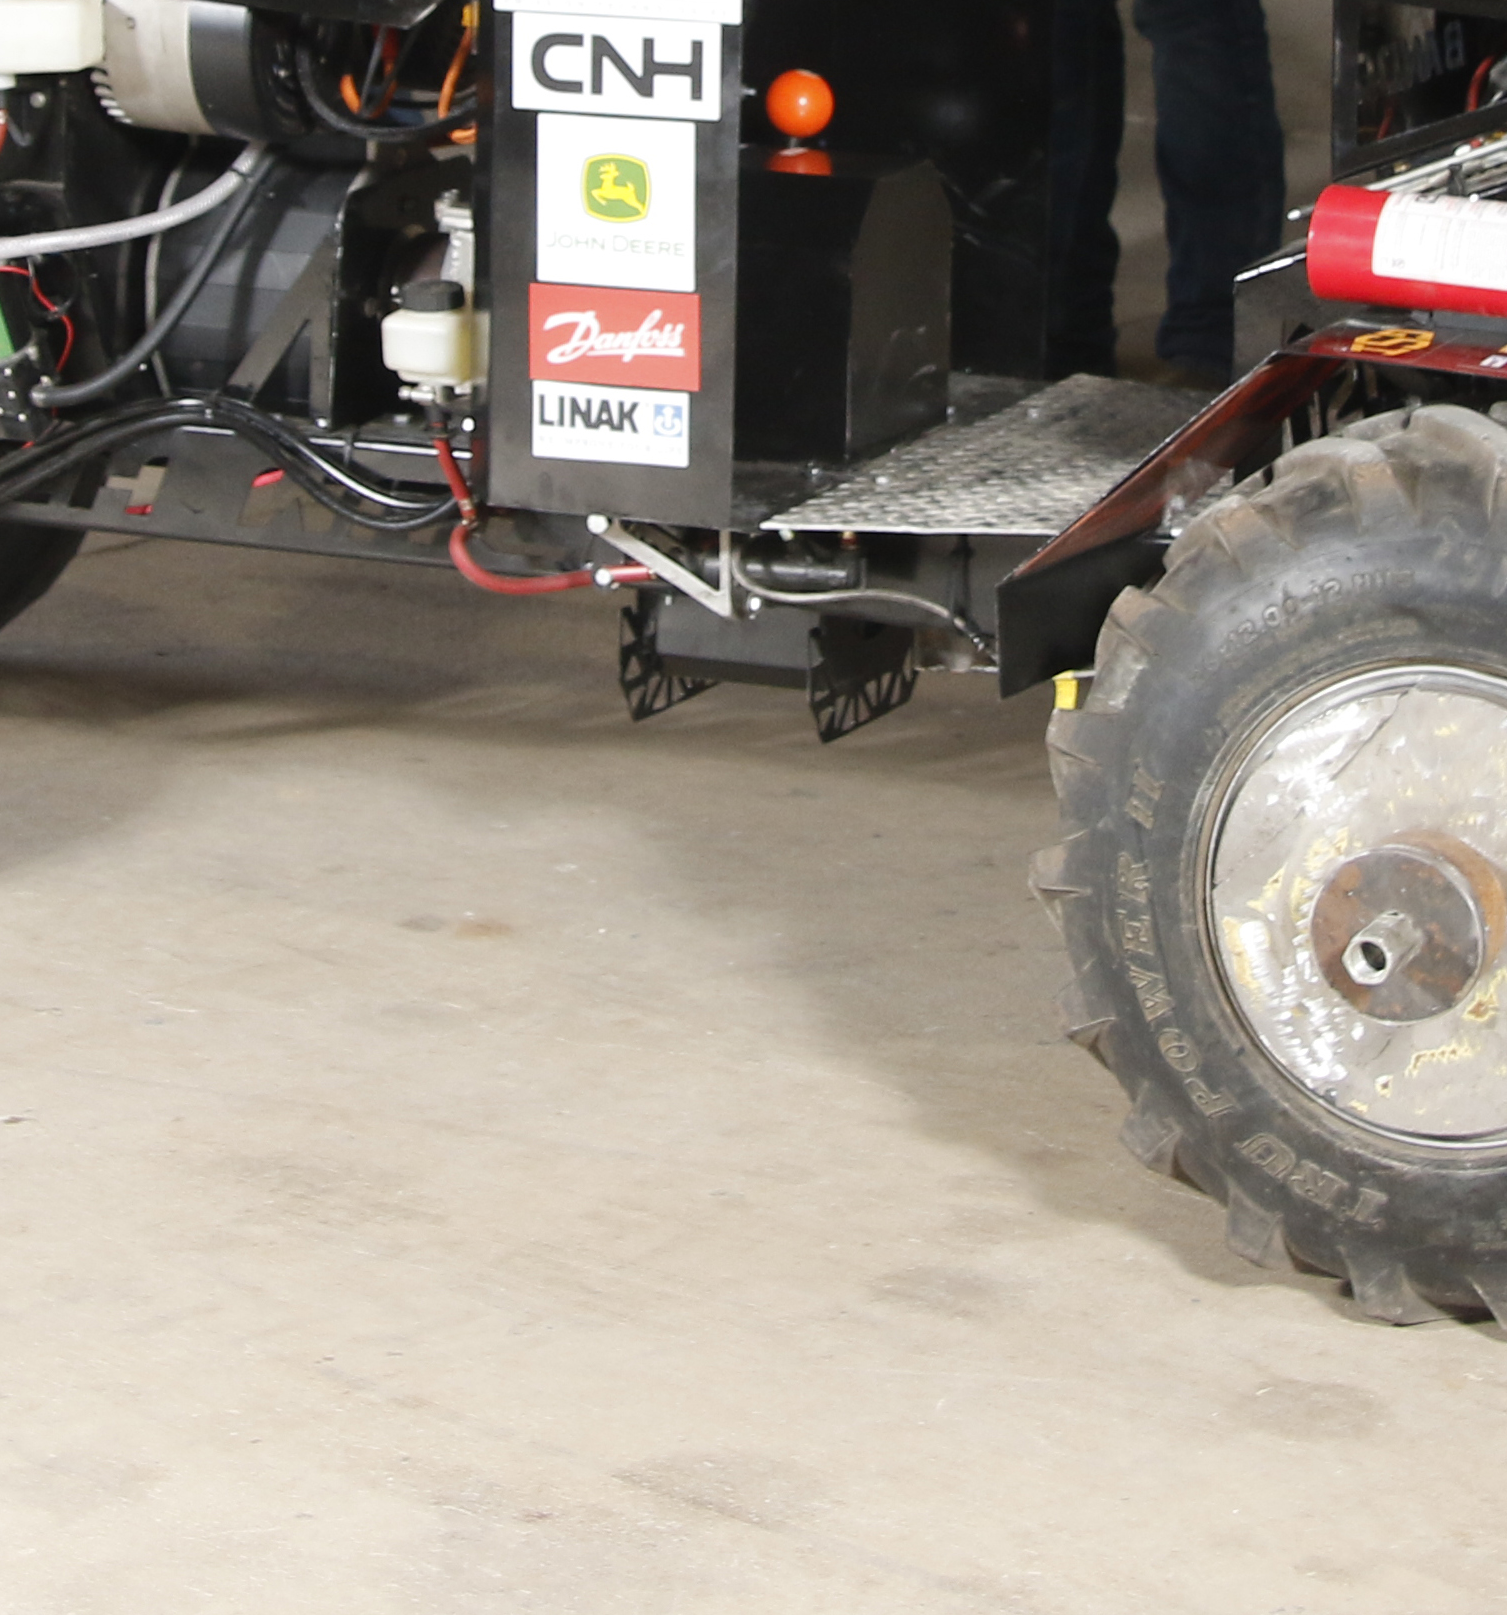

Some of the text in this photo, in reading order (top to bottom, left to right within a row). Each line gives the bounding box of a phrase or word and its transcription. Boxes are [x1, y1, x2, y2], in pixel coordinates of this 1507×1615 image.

[531, 32, 704, 102] CNH
[545, 231, 685, 257] JOHN DEERE
[543, 308, 686, 364] Danfoss
[538, 393, 640, 434] LINAK
[1115, 849, 1243, 1120] POWER
